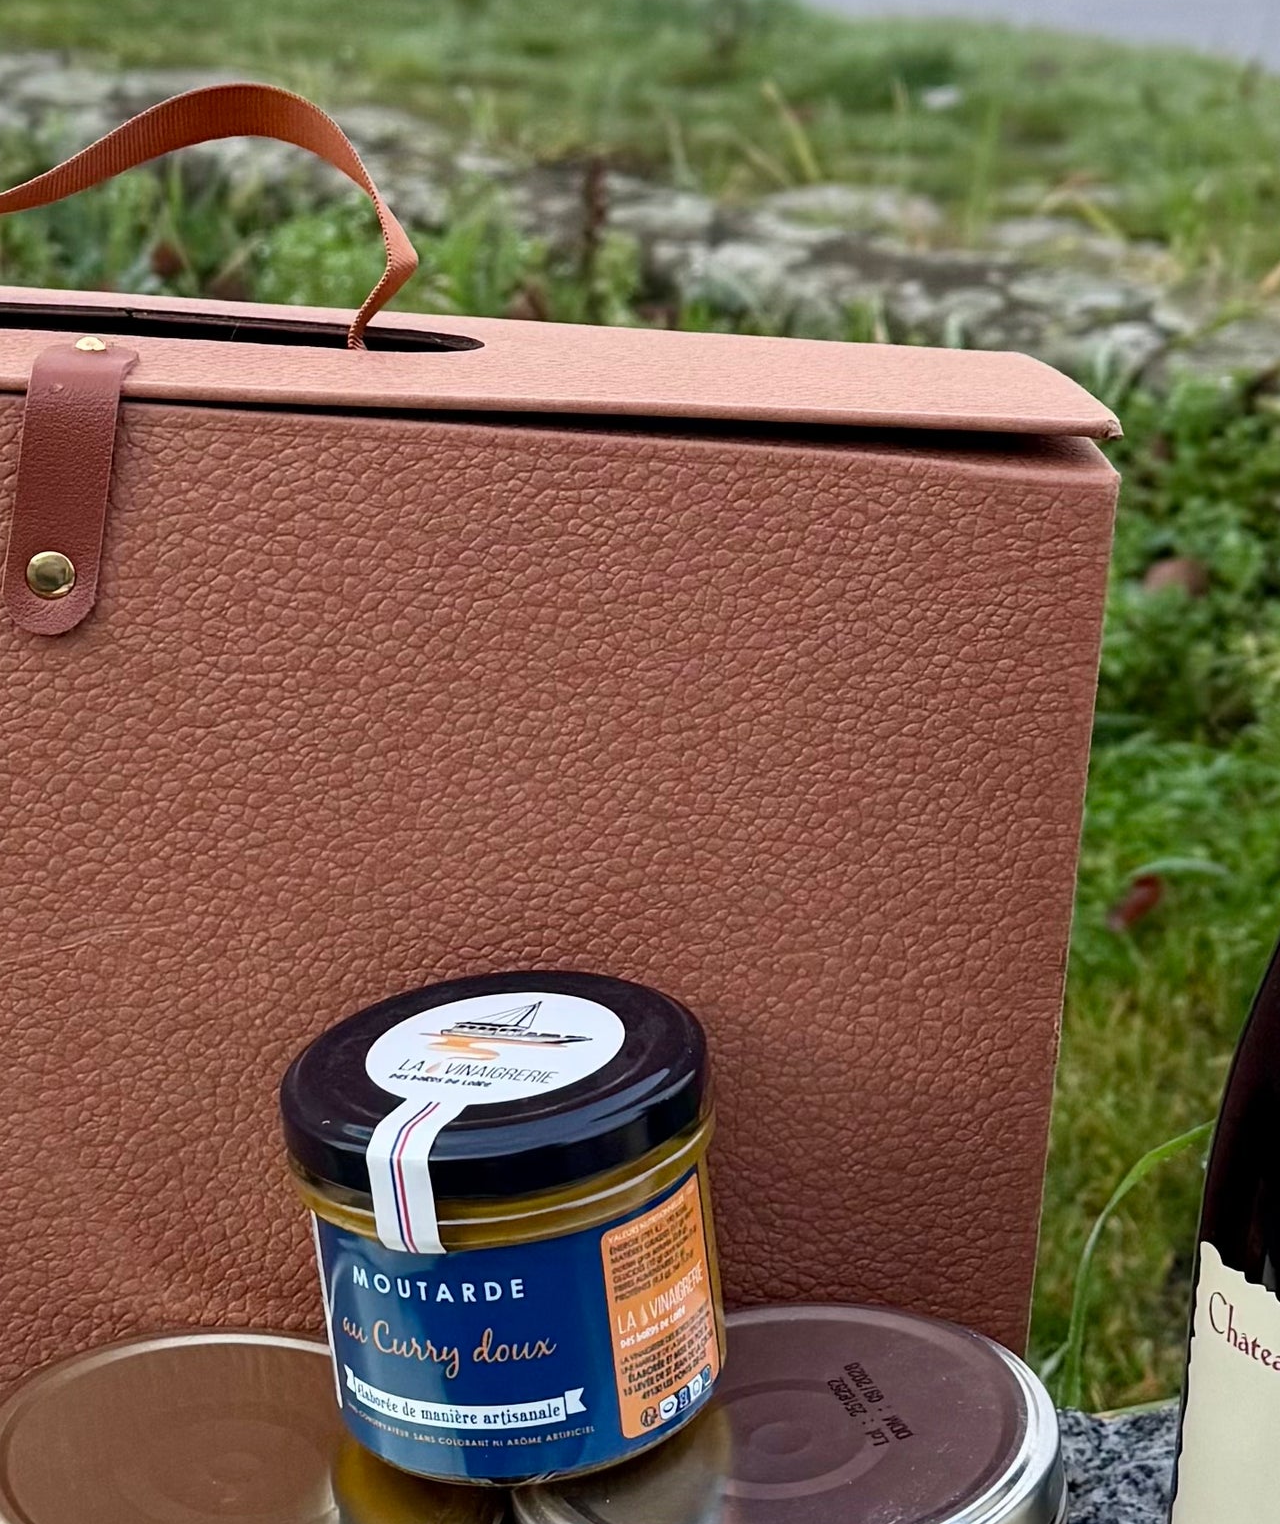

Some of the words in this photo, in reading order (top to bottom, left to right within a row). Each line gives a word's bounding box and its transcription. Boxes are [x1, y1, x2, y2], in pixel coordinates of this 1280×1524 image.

[398, 1059, 425, 1071] LA
[445, 1063, 559, 1084] VINAIGRERIE
[353, 1265, 525, 1303] MOUTARDE
[617, 1310, 636, 1335] LA
[649, 1260, 703, 1319] VINAIGRERIE
[343, 1317, 368, 1344] au
[373, 1320, 460, 1379] Curry
[473, 1327, 557, 1363] doux
[402, 1401, 416, 1417] de
[421, 1408, 477, 1425] manière
[483, 1403, 561, 1426] artisanale
